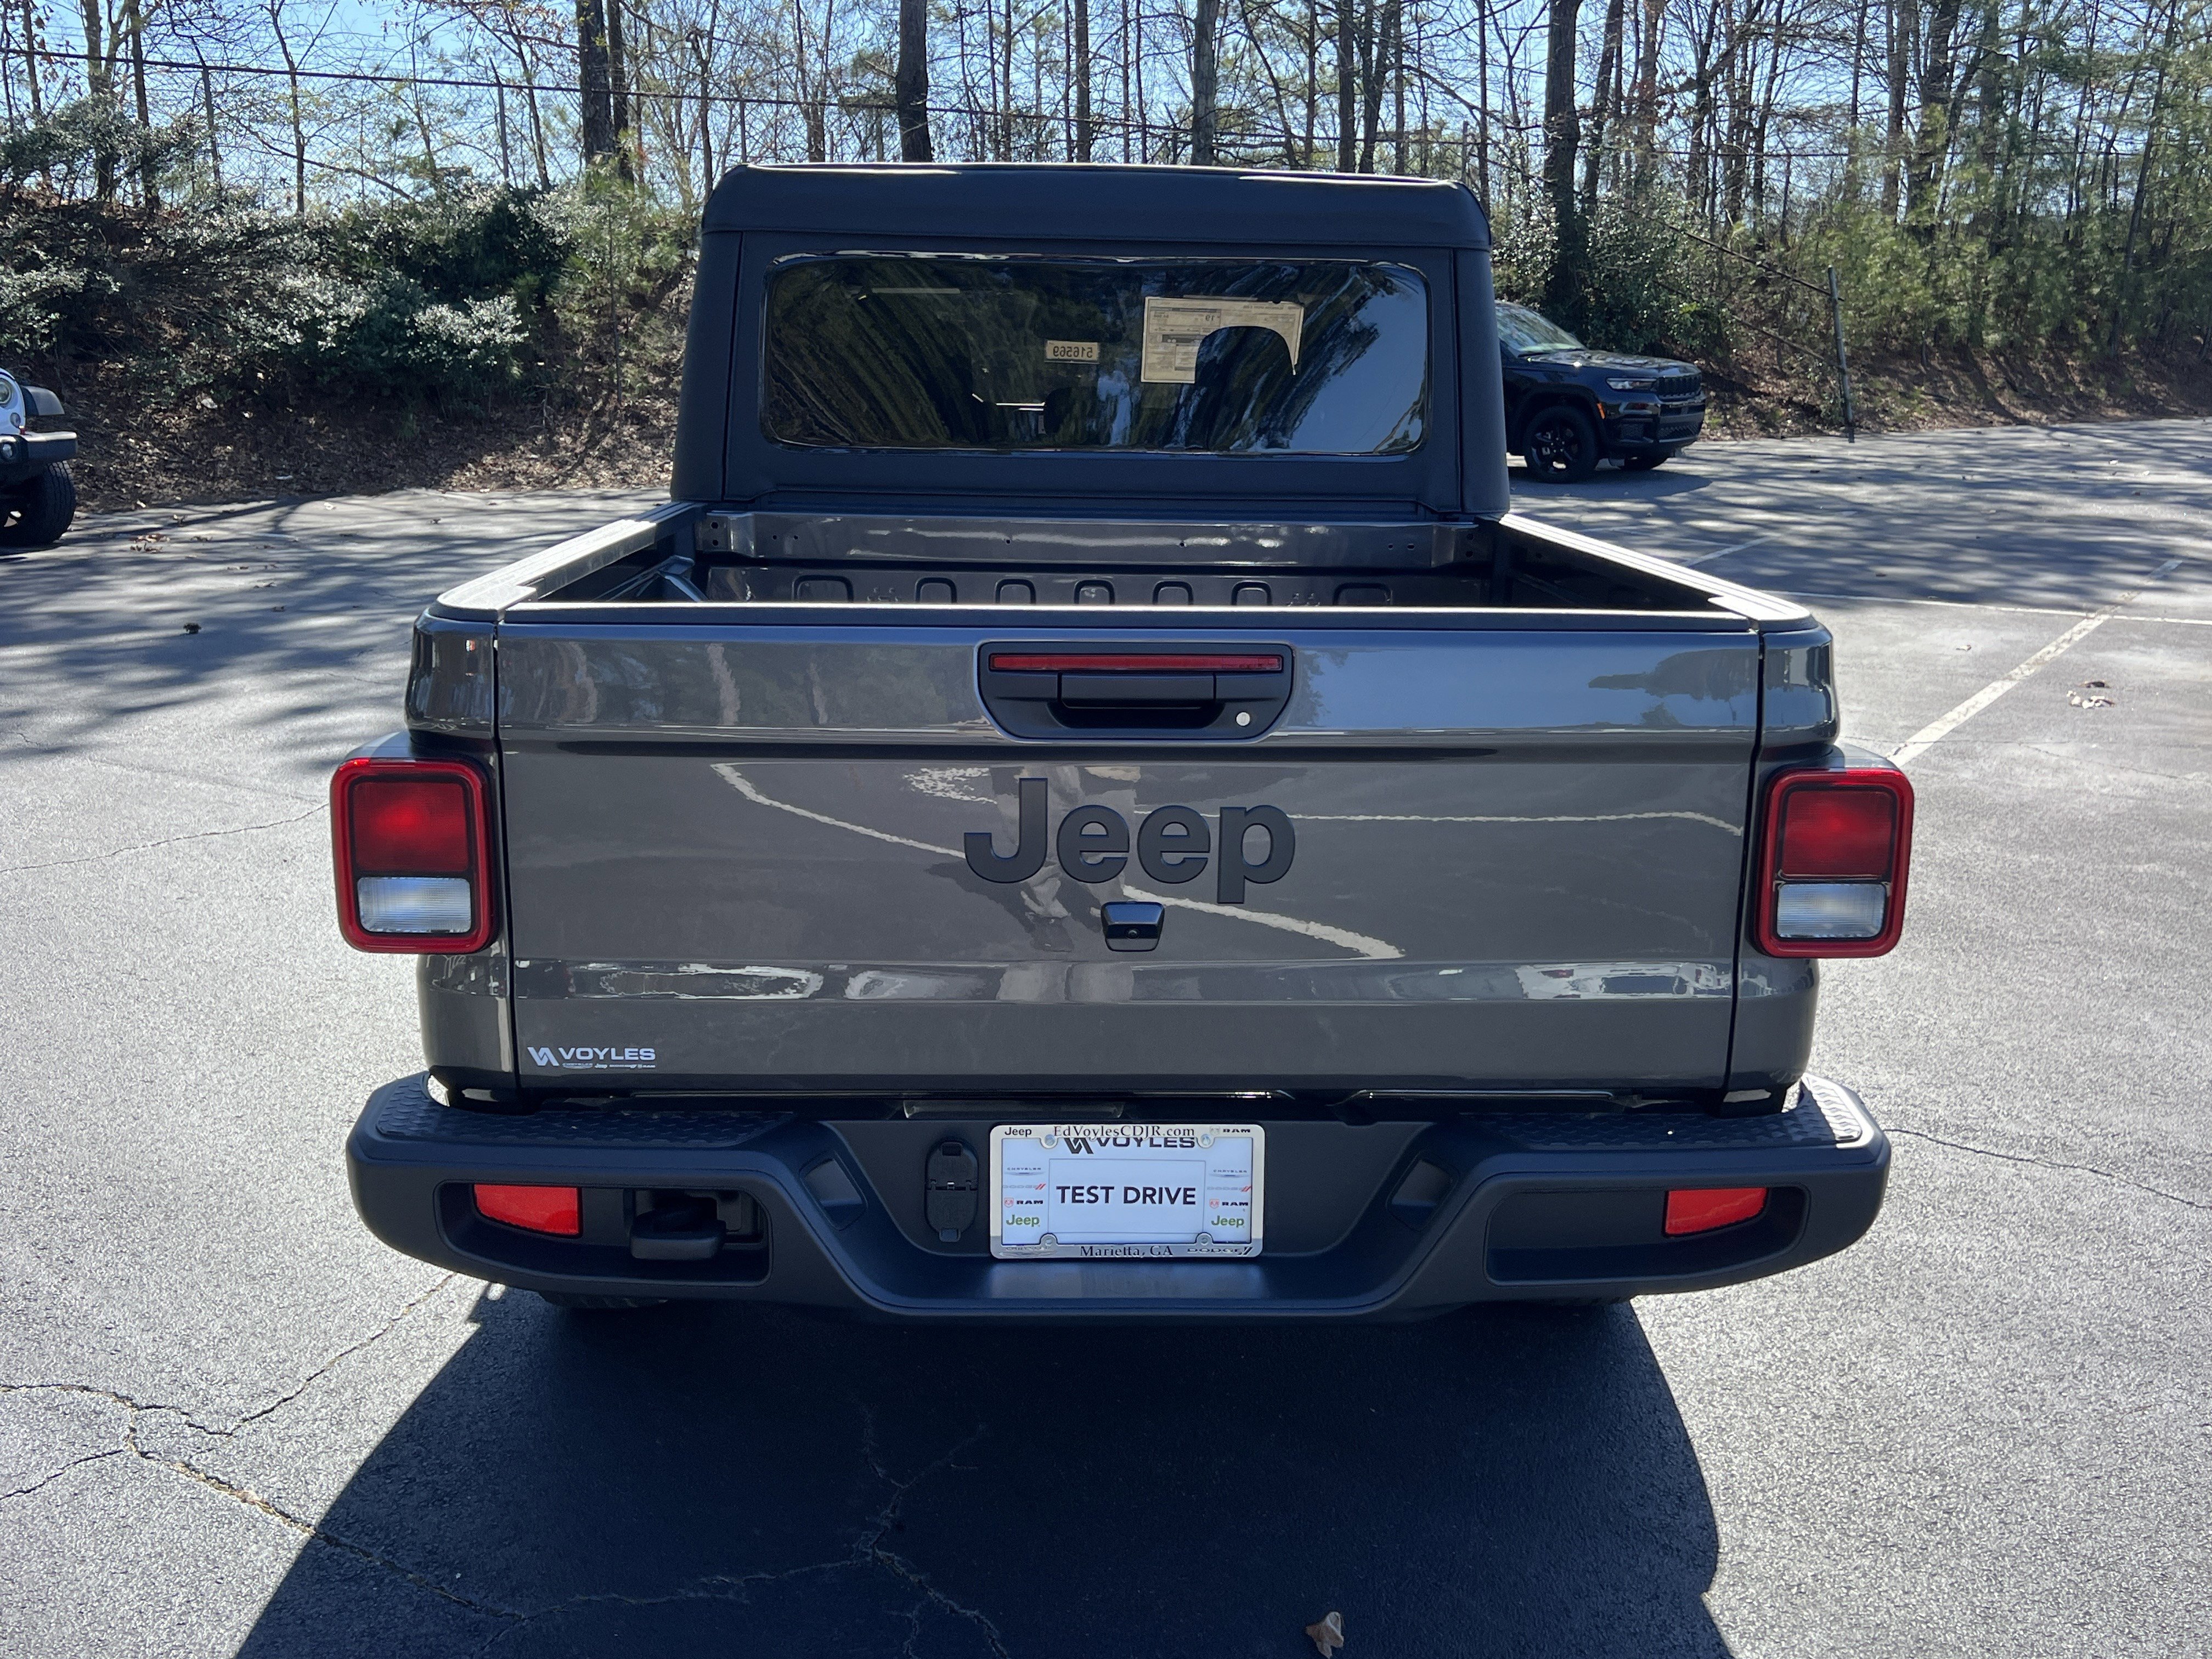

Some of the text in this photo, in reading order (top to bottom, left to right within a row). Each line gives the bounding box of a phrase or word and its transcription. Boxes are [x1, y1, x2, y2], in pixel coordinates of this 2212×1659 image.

[963, 777, 1296, 904] Jeep
[558, 1047, 656, 1060] VOYLES
[1004, 1126, 1032, 1137] Jeep
[1053, 1125, 1195, 1142] EdVoylesCDJR.com
[1096, 1137, 1195, 1148] VOYLES
[1056, 1186, 1196, 1205] TEST DRIVE
[1006, 1214, 1040, 1227] Jeep
[1211, 1215, 1245, 1228] Jeep
[1080, 1245, 1173, 1257] Marietta, GA
